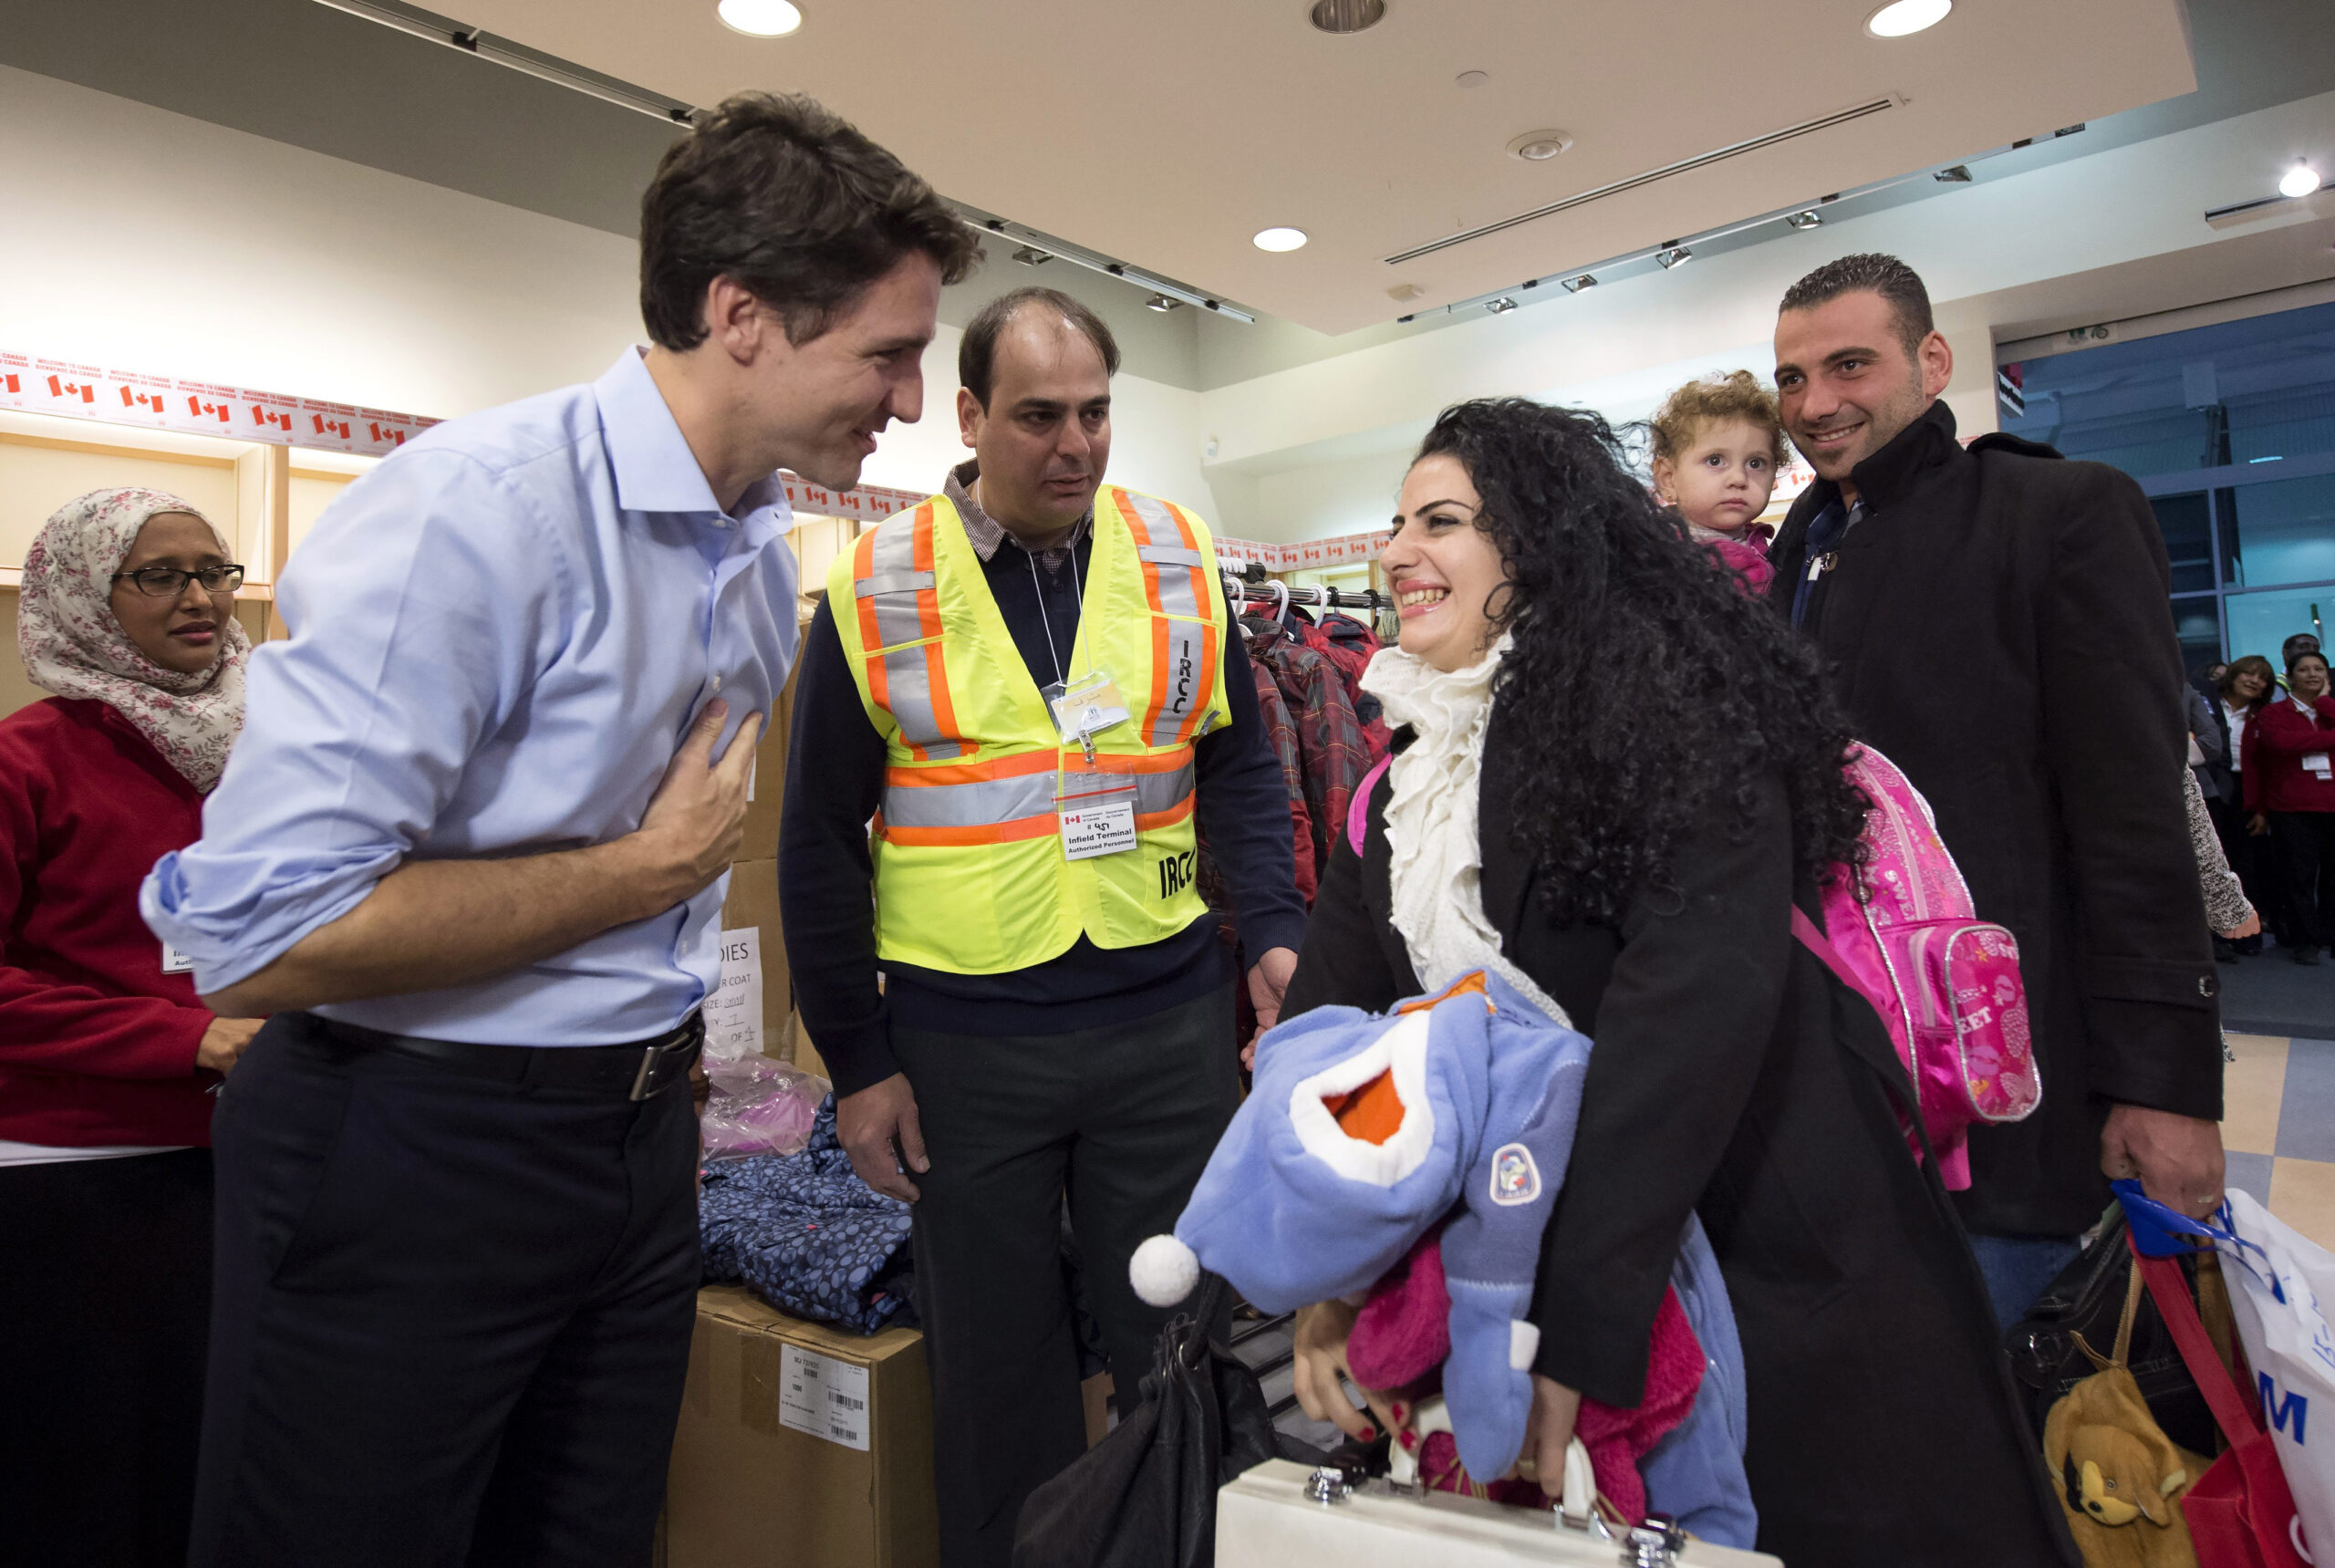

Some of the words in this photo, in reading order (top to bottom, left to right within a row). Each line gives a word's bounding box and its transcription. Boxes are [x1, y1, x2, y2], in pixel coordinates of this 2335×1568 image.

[1173, 640, 1192, 713] IRCC
[1068, 834, 1095, 845] Infield
[1096, 828, 1132, 840] Terminal
[1068, 843, 1102, 854] Authorized
[1104, 838, 1135, 848] Personnel
[1159, 846, 1196, 899] IRCC
[730, 973, 751, 986] COAT
[731, 1033, 742, 1042] OF
